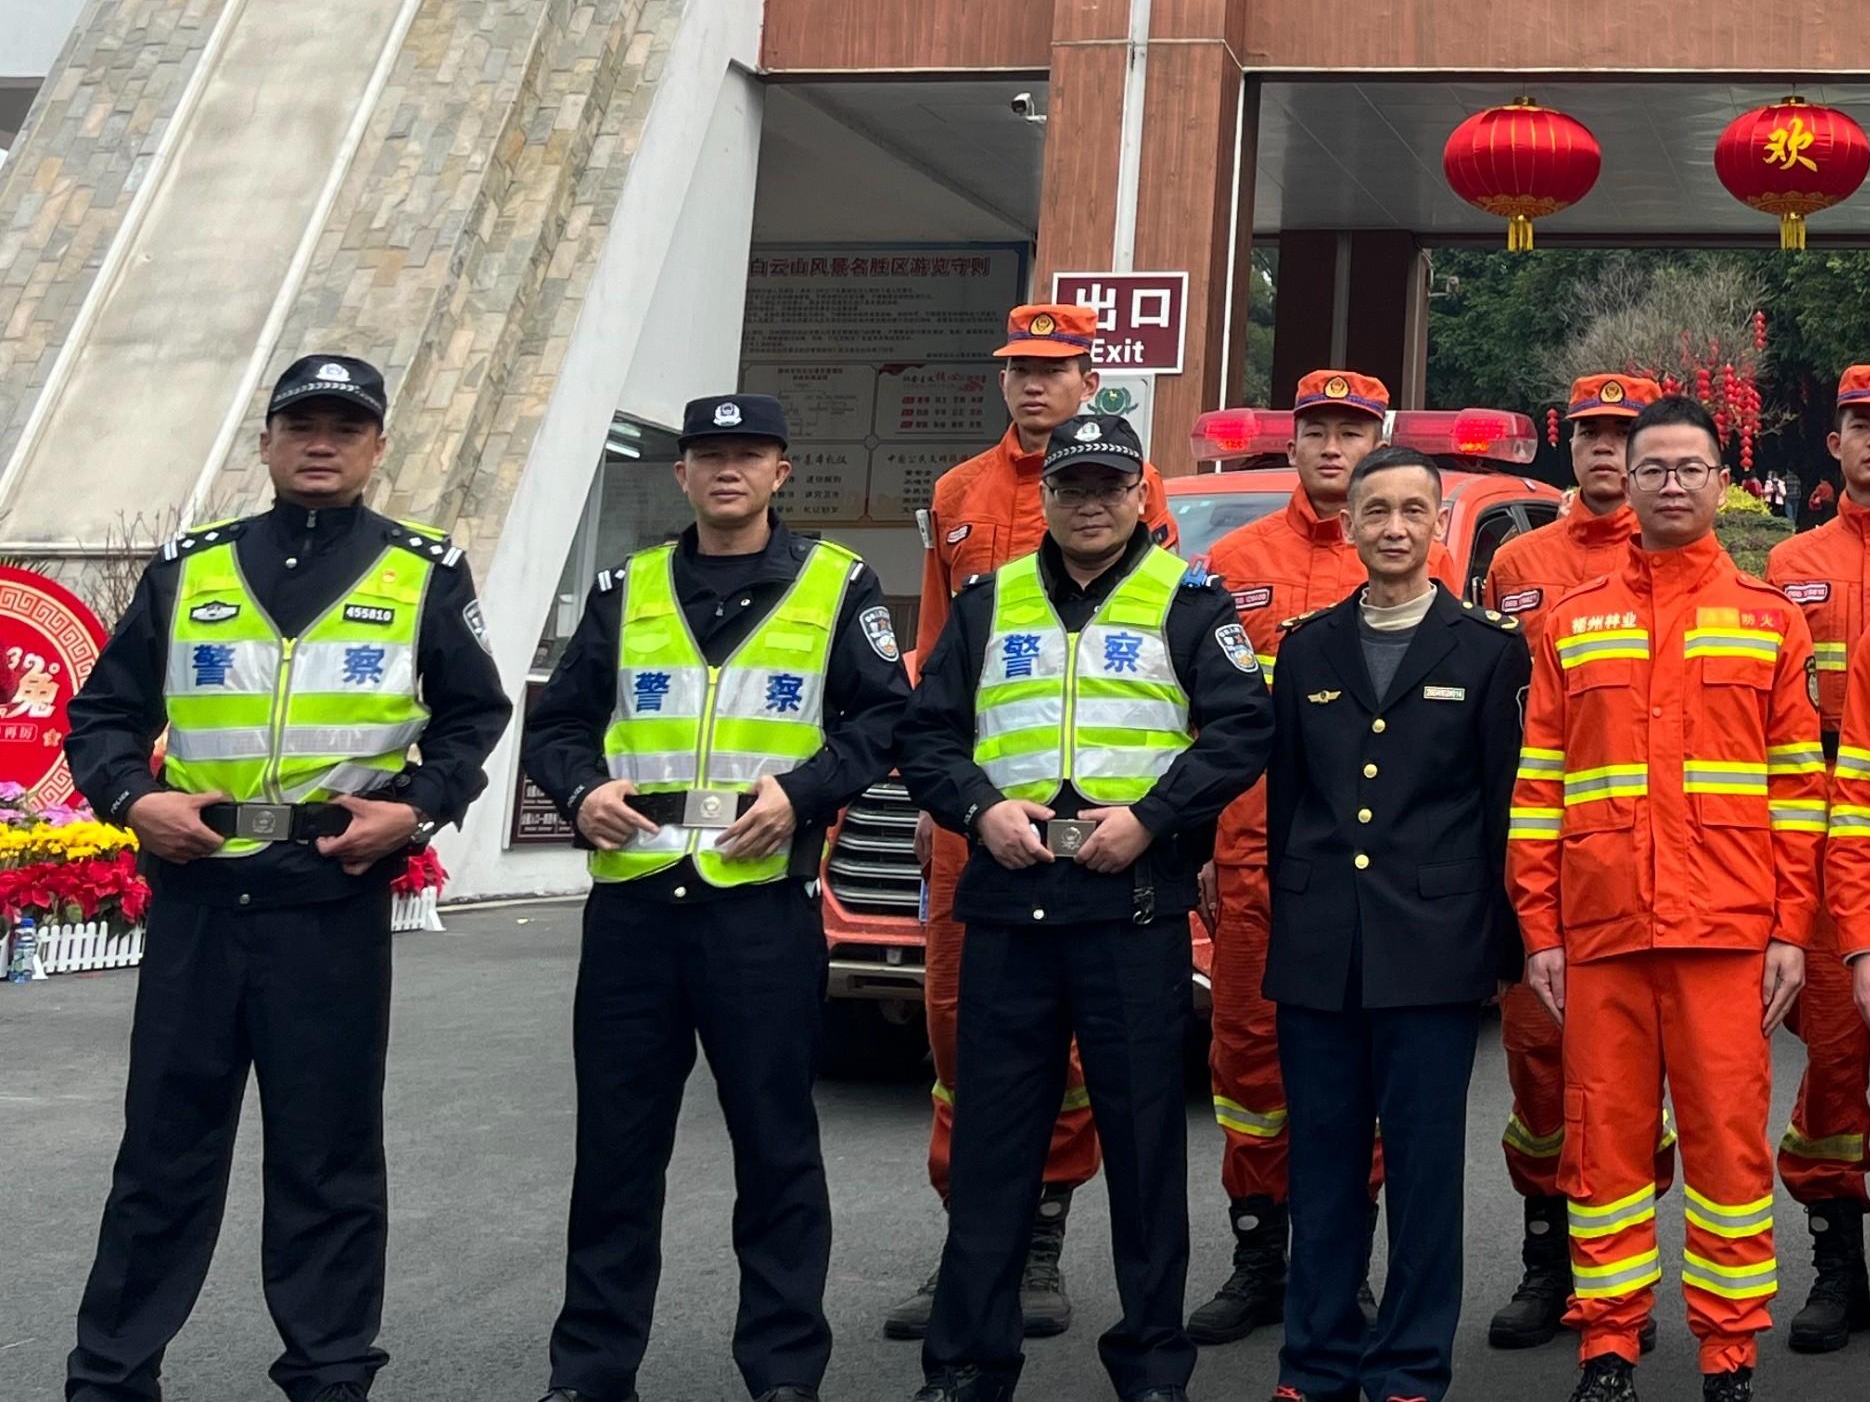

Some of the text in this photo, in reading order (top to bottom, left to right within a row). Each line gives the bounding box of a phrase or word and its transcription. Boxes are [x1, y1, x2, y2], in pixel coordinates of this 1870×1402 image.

[1762, 117, 1818, 173] 欢
[750, 256, 992, 278] 白云山风景名胜区游览守则
[1076, 283, 1171, 332] 出口
[1091, 338, 1145, 363] Exit
